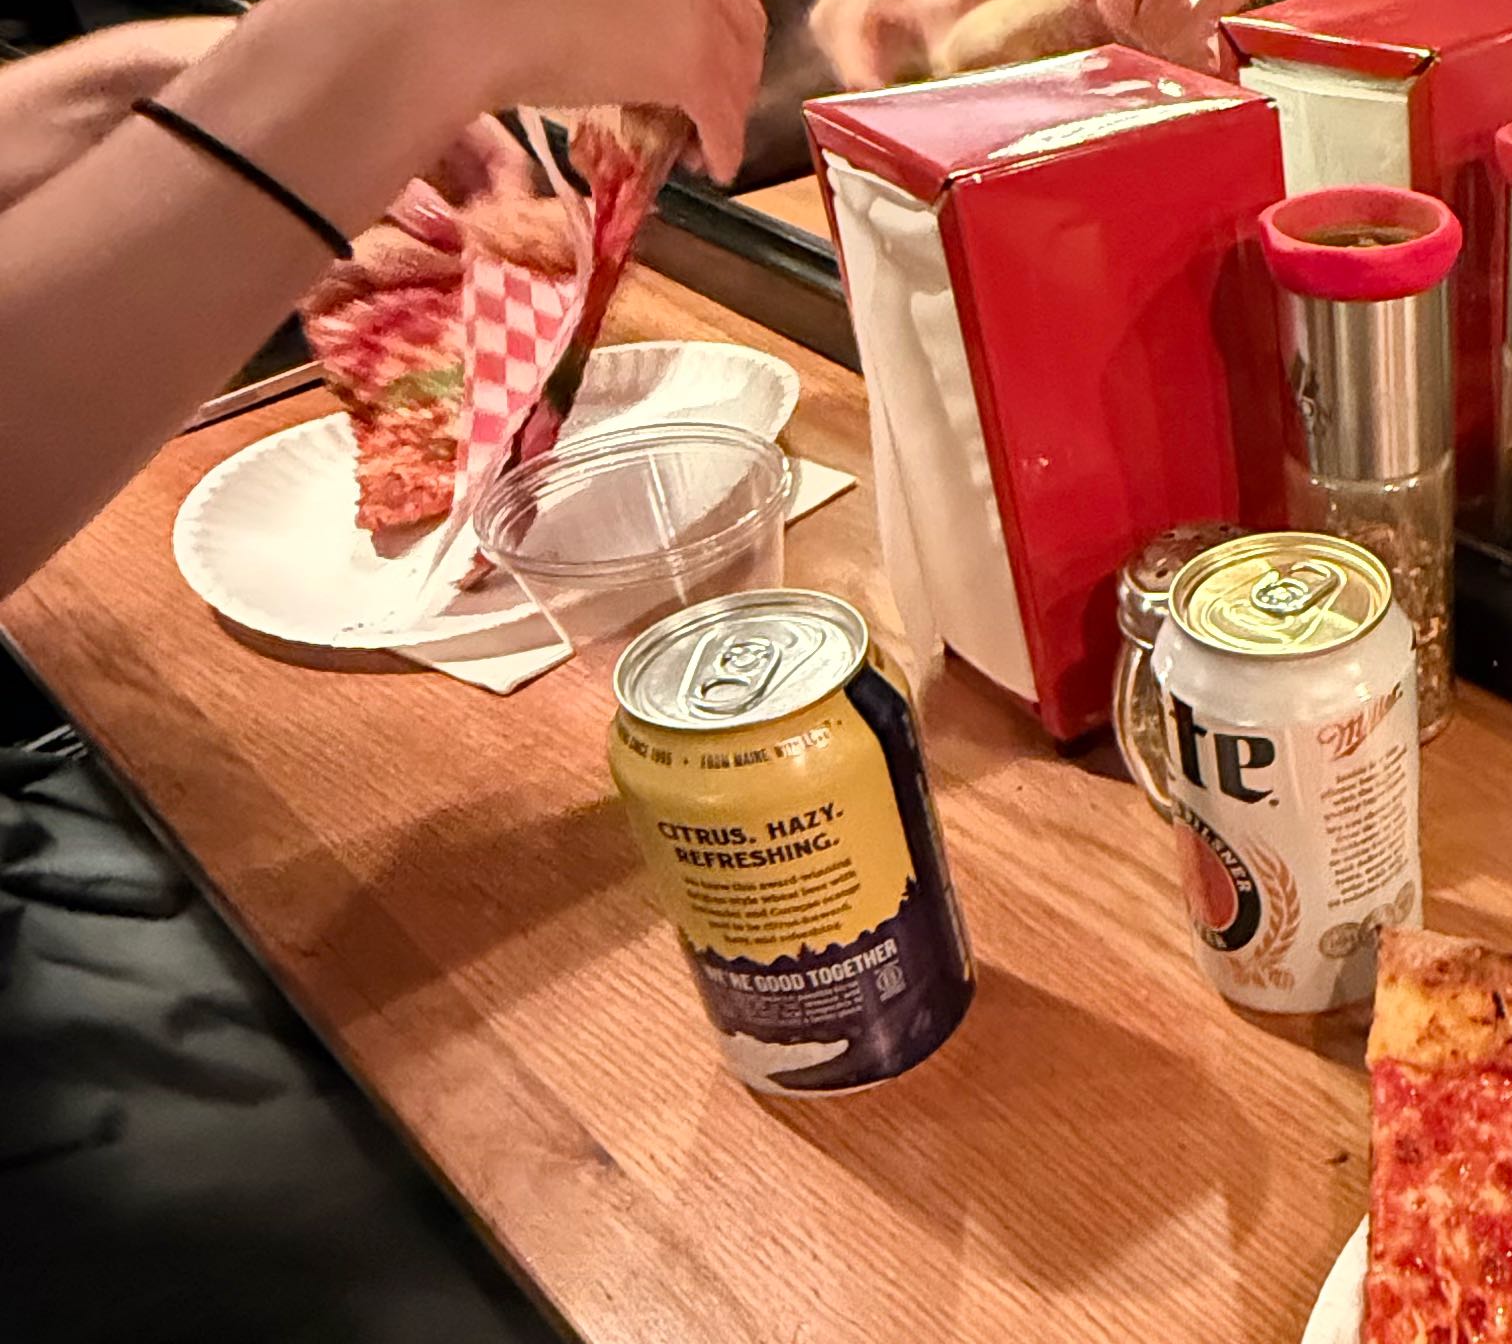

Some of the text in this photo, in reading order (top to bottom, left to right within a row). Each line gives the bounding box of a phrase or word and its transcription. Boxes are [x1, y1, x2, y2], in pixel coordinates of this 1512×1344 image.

[1169, 689, 1277, 806] te
[658, 801, 844, 846] CITRUS. HAZY.
[674, 832, 840, 869] REFRESHING.
[754, 973, 805, 993] GOOD
[806, 937, 899, 988] TOGETHER
